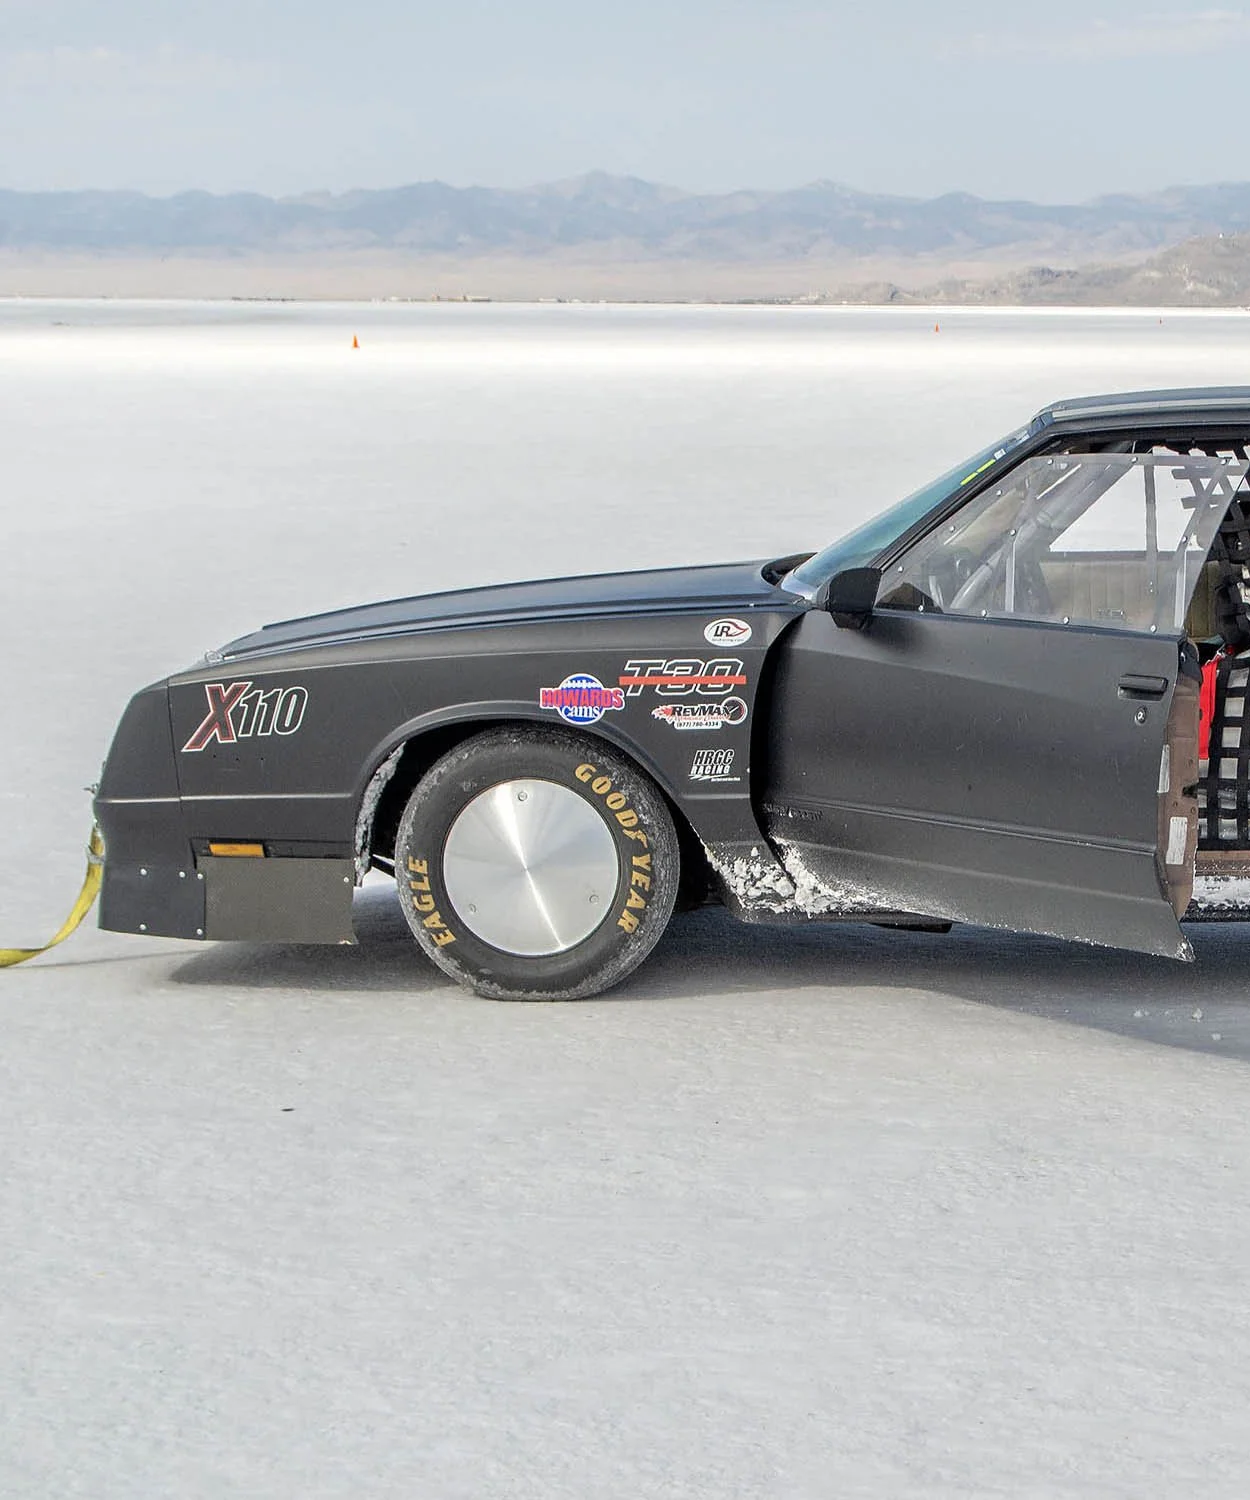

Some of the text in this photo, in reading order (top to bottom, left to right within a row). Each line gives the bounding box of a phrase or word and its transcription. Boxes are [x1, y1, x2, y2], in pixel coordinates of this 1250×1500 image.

[181, 681, 309, 752] X110
[541, 688, 624, 708] HOWARDS
[693, 749, 734, 765] HRGC
[407, 855, 457, 948] EAGLE
